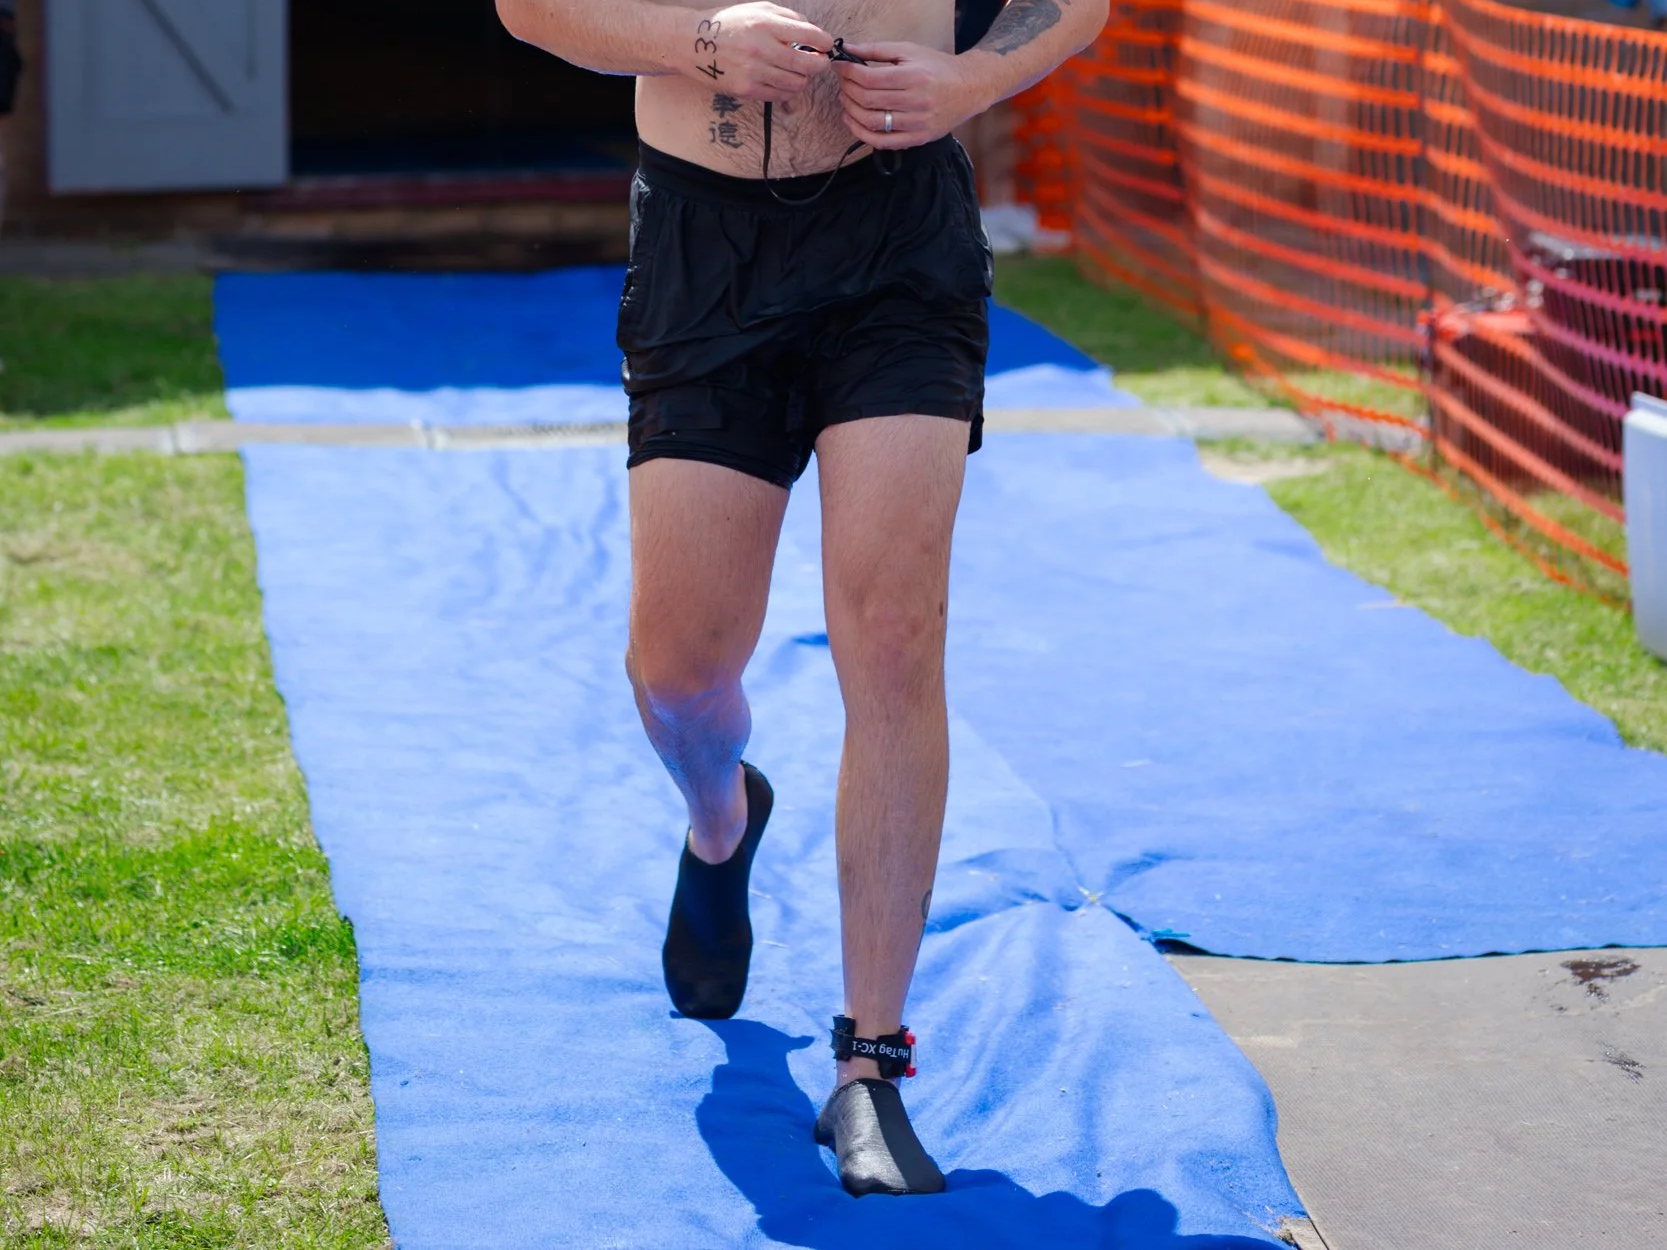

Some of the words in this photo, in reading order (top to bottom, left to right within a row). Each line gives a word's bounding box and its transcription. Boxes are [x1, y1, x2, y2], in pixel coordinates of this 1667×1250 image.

[695, 19, 725, 80] 433
[852, 1041, 877, 1054] XC-1
[879, 1043, 909, 1059] HuTag
